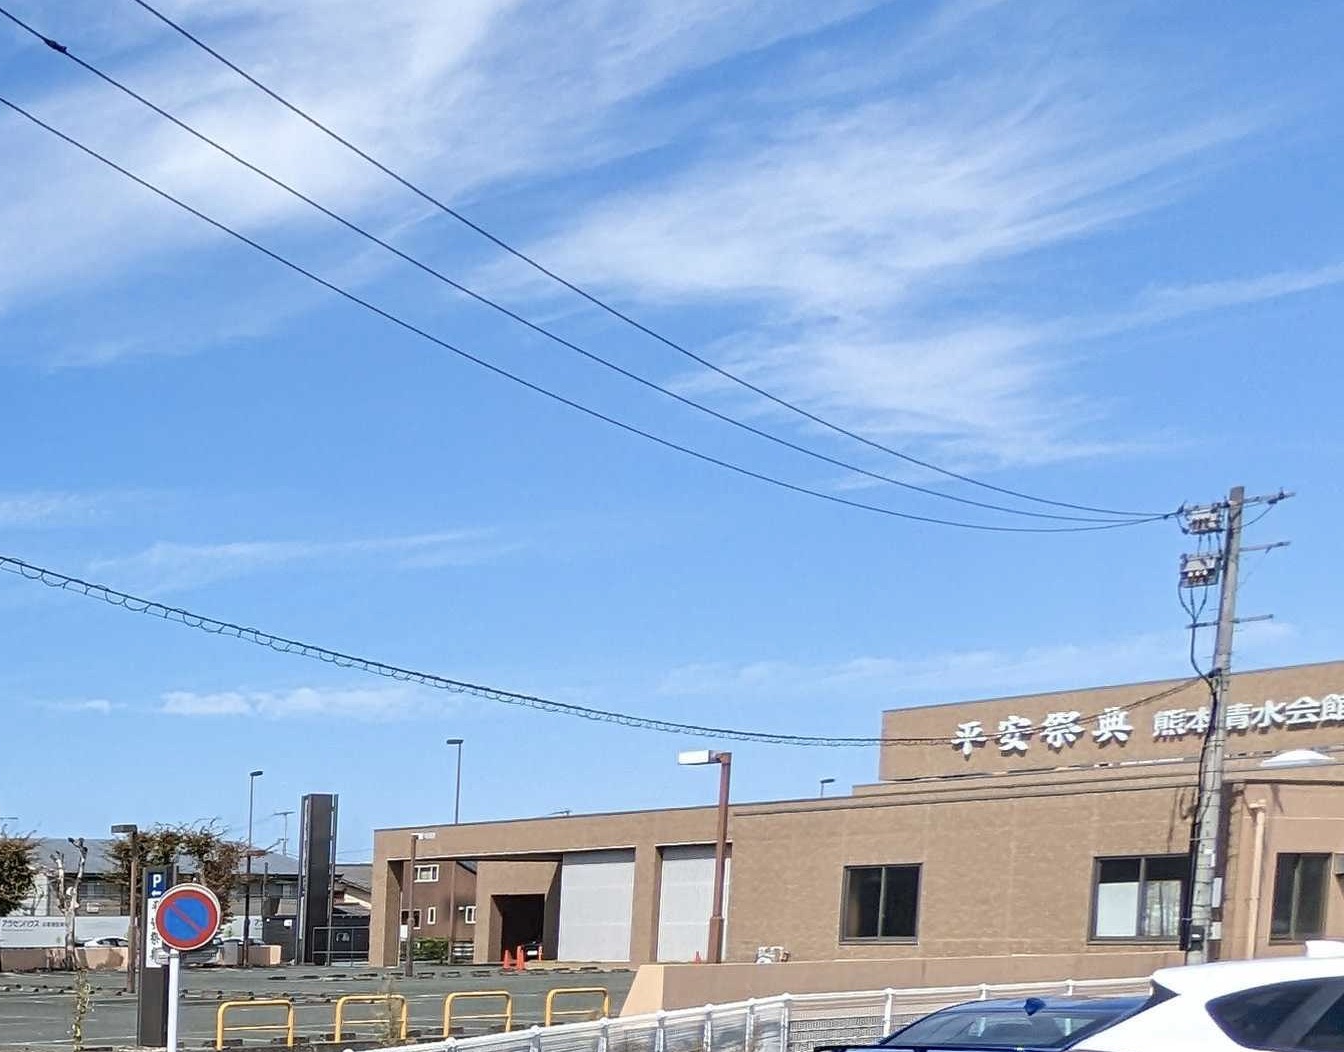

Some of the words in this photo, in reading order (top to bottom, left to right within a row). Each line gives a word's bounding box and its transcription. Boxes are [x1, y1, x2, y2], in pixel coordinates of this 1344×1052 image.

[950, 704, 1135, 756] 平安祭典
[153, 874, 162, 888] P
